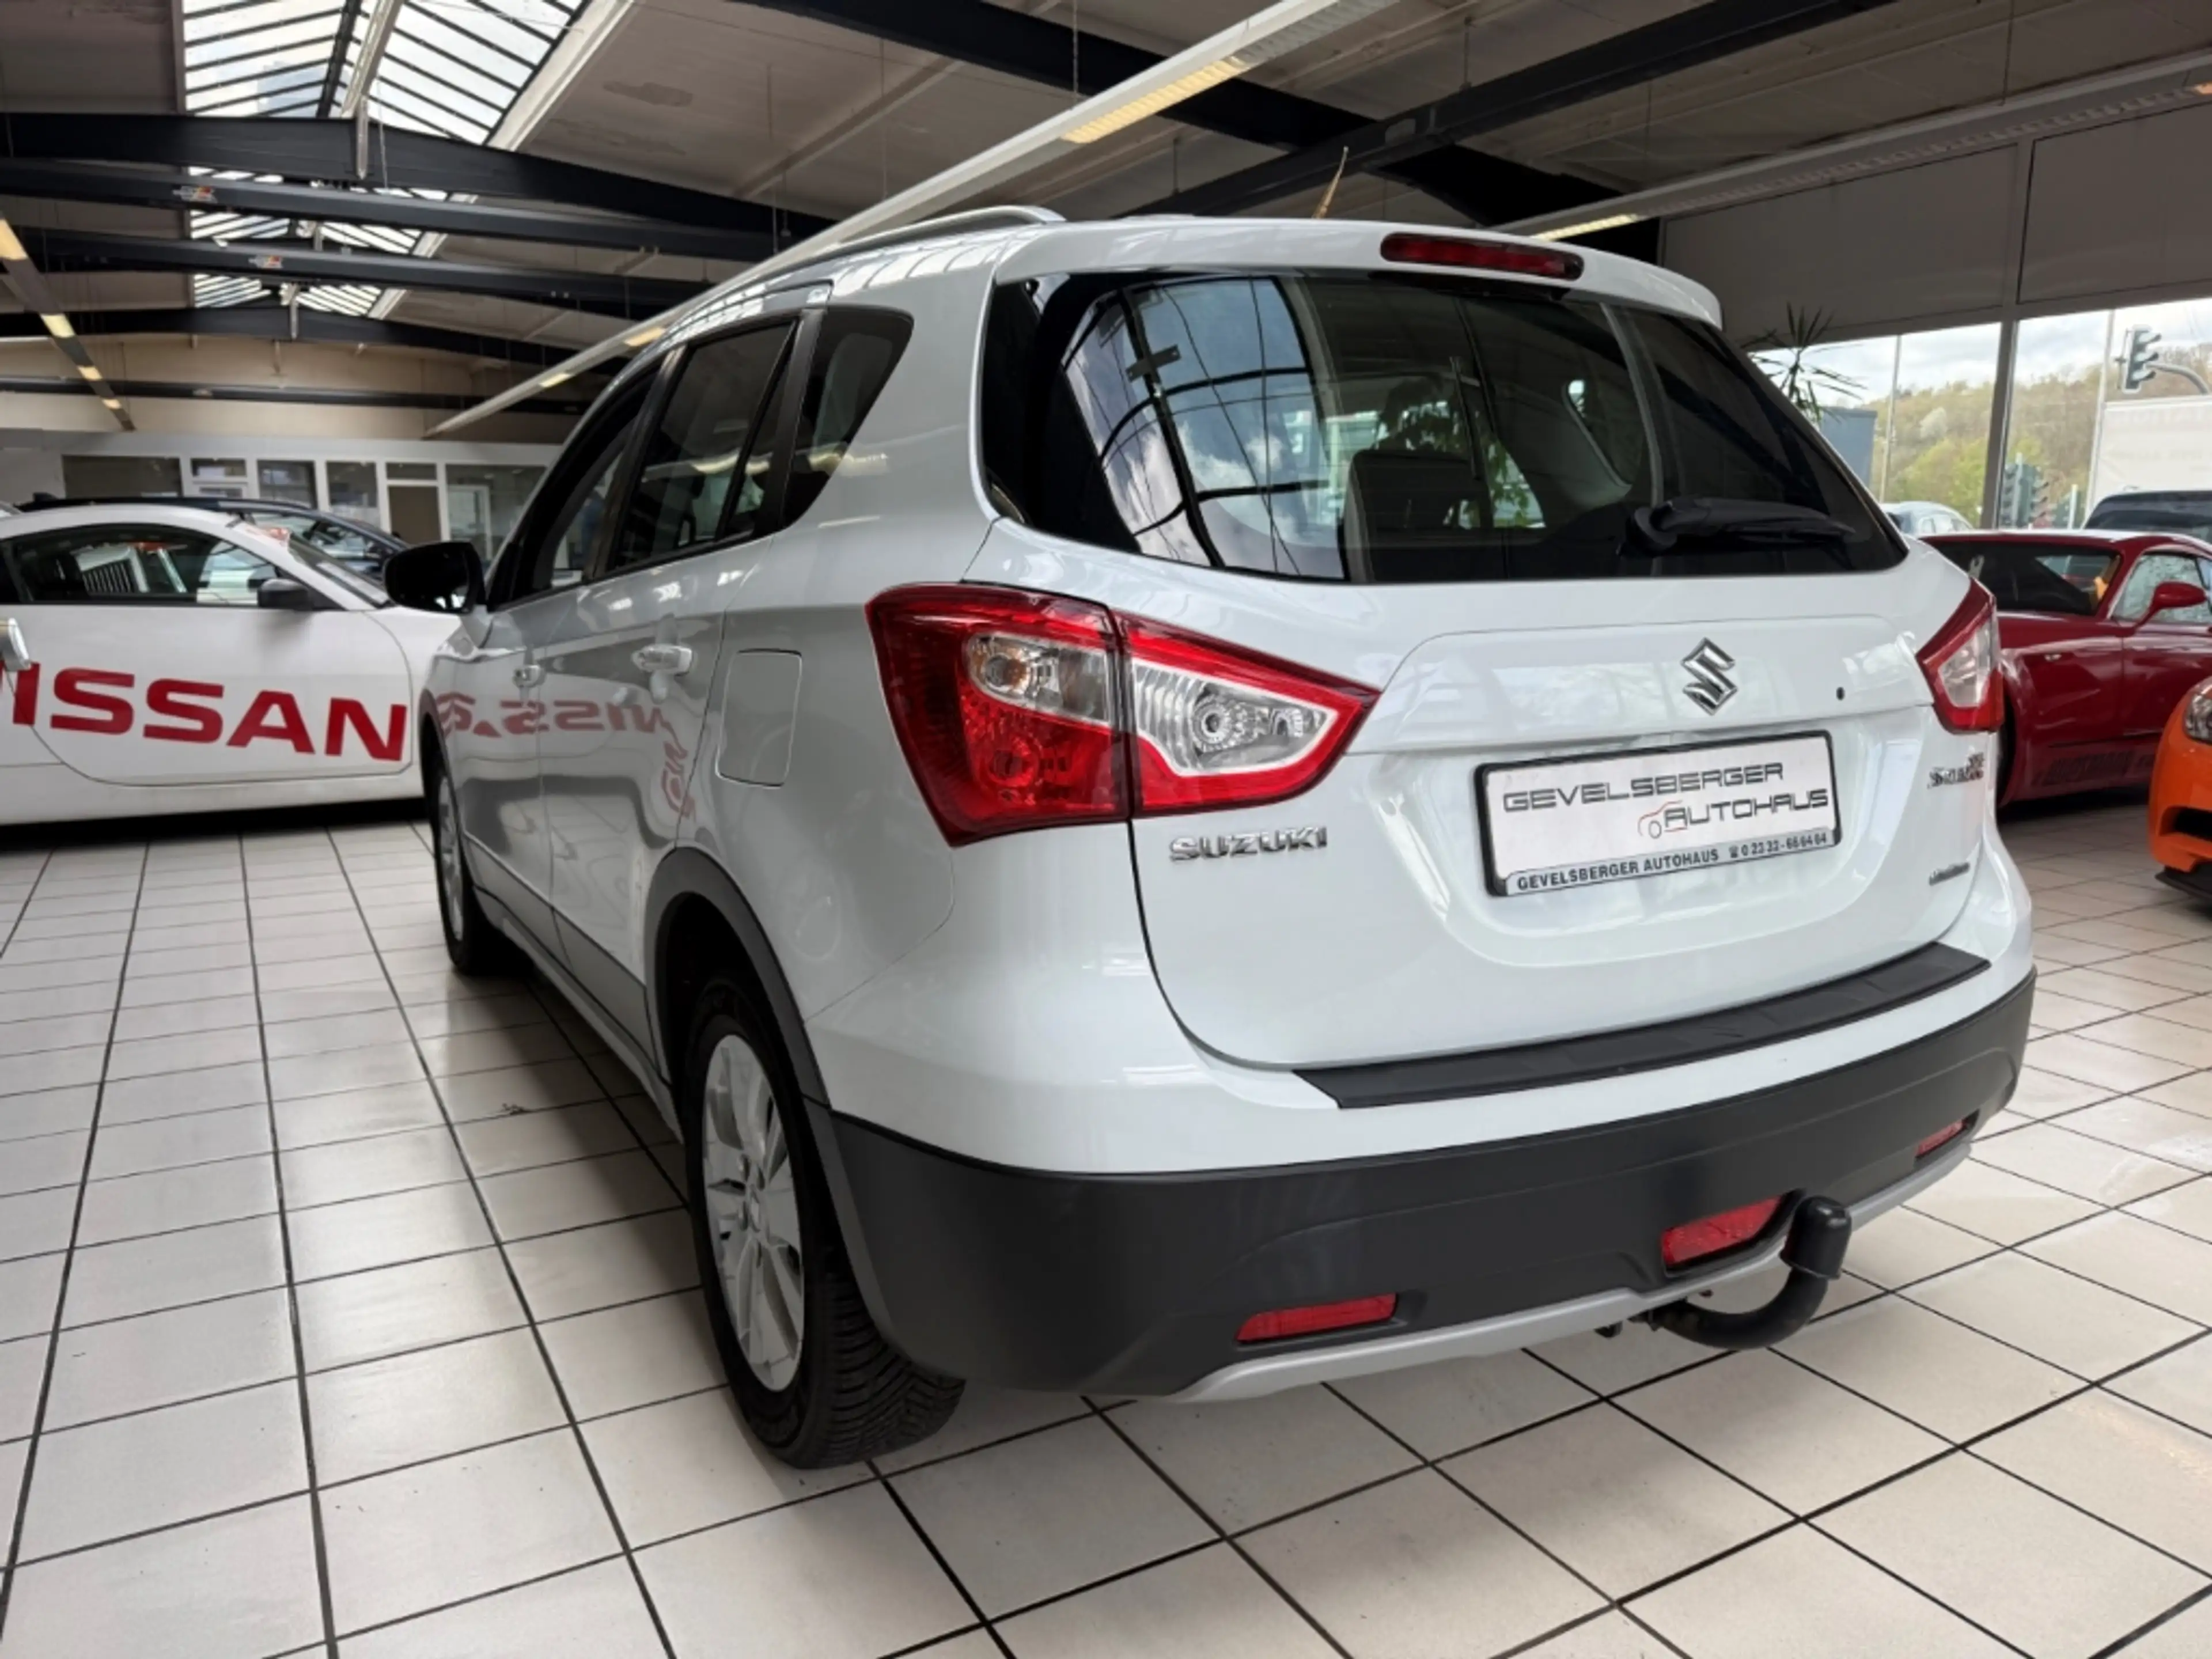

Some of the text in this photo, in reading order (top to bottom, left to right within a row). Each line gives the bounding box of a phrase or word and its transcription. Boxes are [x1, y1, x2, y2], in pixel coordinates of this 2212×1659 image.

[0, 660, 407, 762] ISSAN
[1503, 762, 1784, 813] GEVELSBERGER
[1664, 788, 1828, 828] AUTOHAUS
[1169, 827, 1327, 862] SUZUKI
[1517, 862, 1639, 891] GEVELSBERGER
[1643, 849, 1719, 872] AUTOHAUS
